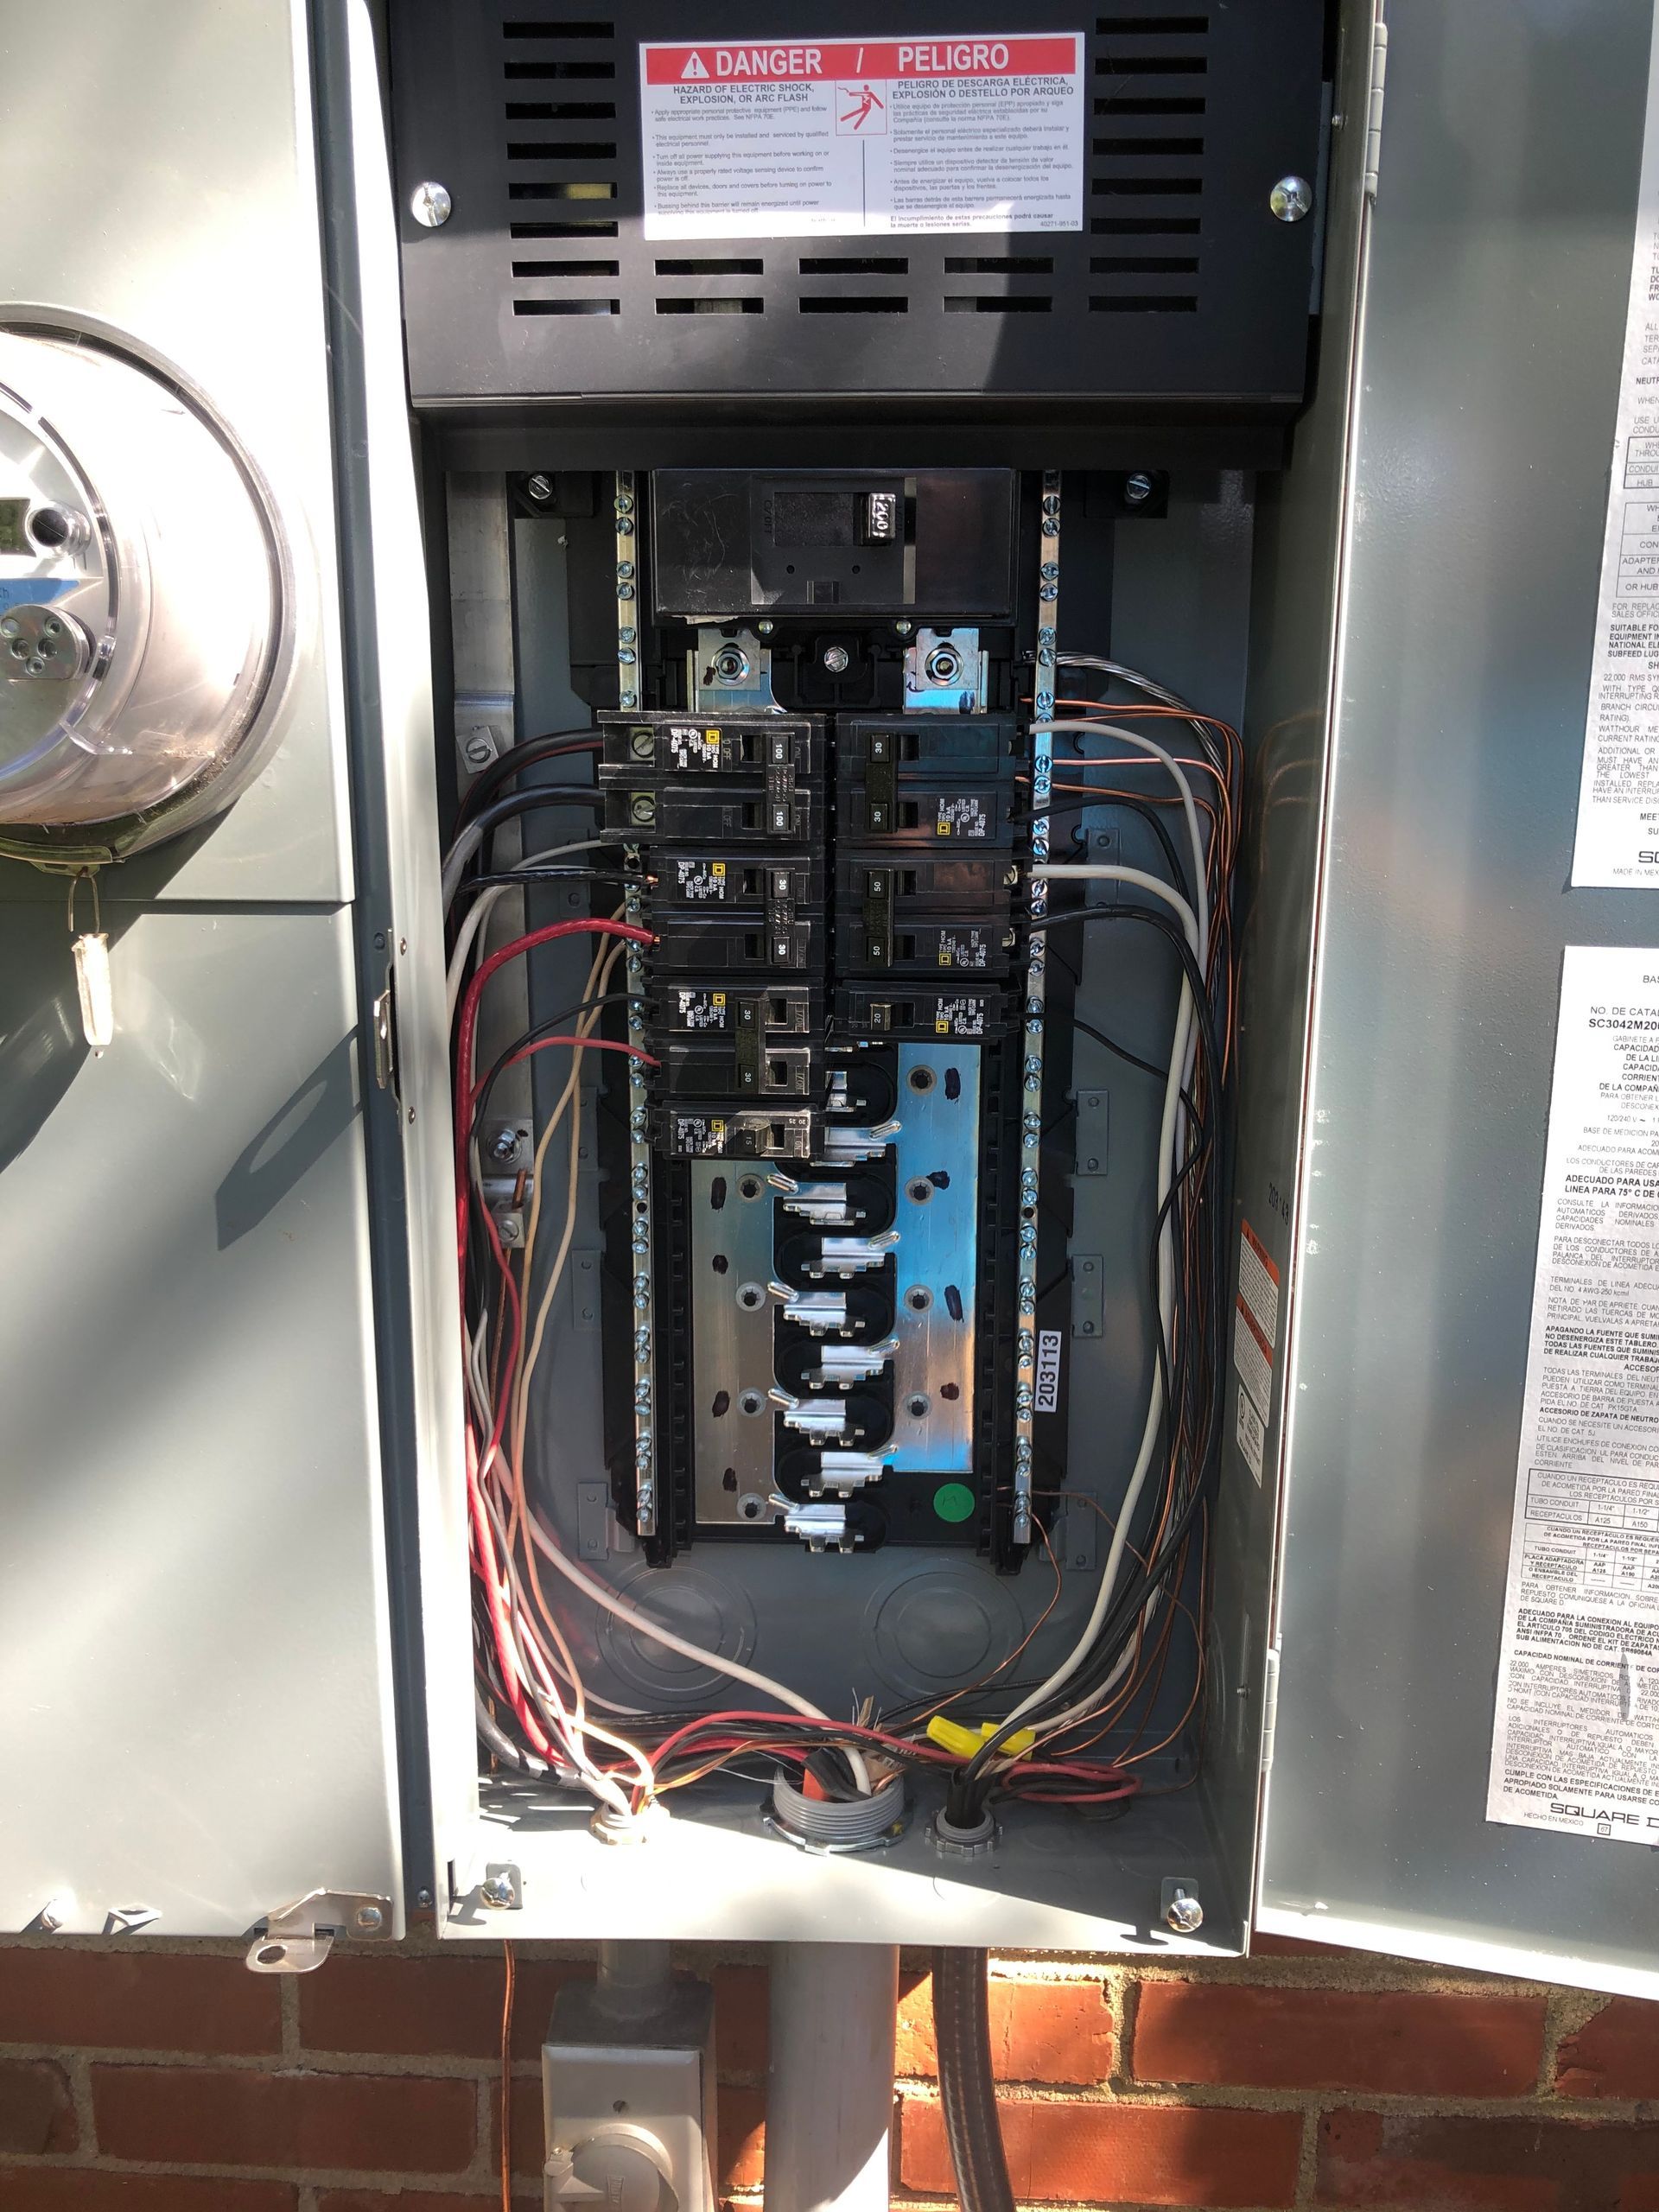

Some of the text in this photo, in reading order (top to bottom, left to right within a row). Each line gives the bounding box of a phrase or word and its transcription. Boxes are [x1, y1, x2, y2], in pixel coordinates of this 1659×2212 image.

[715, 48, 823, 76] DANGER
[899, 43, 1009, 71] PELIGRO
[898, 80, 938, 89] PELIGRO
[957, 79, 1010, 87] DESCARGA
[1014, 76, 1068, 86] ELÉCTRICA,
[779, 84, 814, 92] SHOCK,
[893, 89, 945, 99] EXPLOSIÓN
[1011, 88, 1030, 97] POR
[680, 95, 735, 105] EXPLOSION,
[875, 742, 881, 753] 30
[874, 811, 881, 822] 30
[779, 880, 785, 890] 30
[874, 882, 880, 892] 50
[779, 944, 785, 955] 30
[874, 946, 880, 956] 50
[745, 1010, 751, 1020] 30
[874, 1013, 880, 1023] 20
[1589, 1019, 1659, 1030] SC3042M20
[745, 1072, 751, 1082] 30
[746, 1136, 752, 1145] 15
[1566, 1175, 1640, 1186] ADECUADO PARA
[1556, 1215, 1603, 1224] CAPACIDADES
[1551, 1276, 1592, 1285] TERMINALES
[1546, 1325, 1584, 1334] APAGANDO
[1557, 1334, 1604, 1343] DESENERGIZA
[1039, 1335, 1058, 1407] 203113
[1535, 1459, 1572, 1468] CORRIENTE
[1549, 1499, 1579, 1508] CONDUIT
[1530, 1510, 1582, 1521] RECEPTACULOS
[1518, 1609, 1554, 1618] ADECUADO
[1587, 1617, 1621, 1625] CONEXION
[1515, 1650, 1583, 1664] CAPACIDAD NOMINAL
[1505, 1770, 1534, 1778] CUMPLE
[1504, 1778, 1646, 1804] APROPIADO SOLAMENTE PARA USARSE
[1550, 1802, 1639, 1825] SQUARE
[1559, 1817, 1583, 1826] MEXICO
